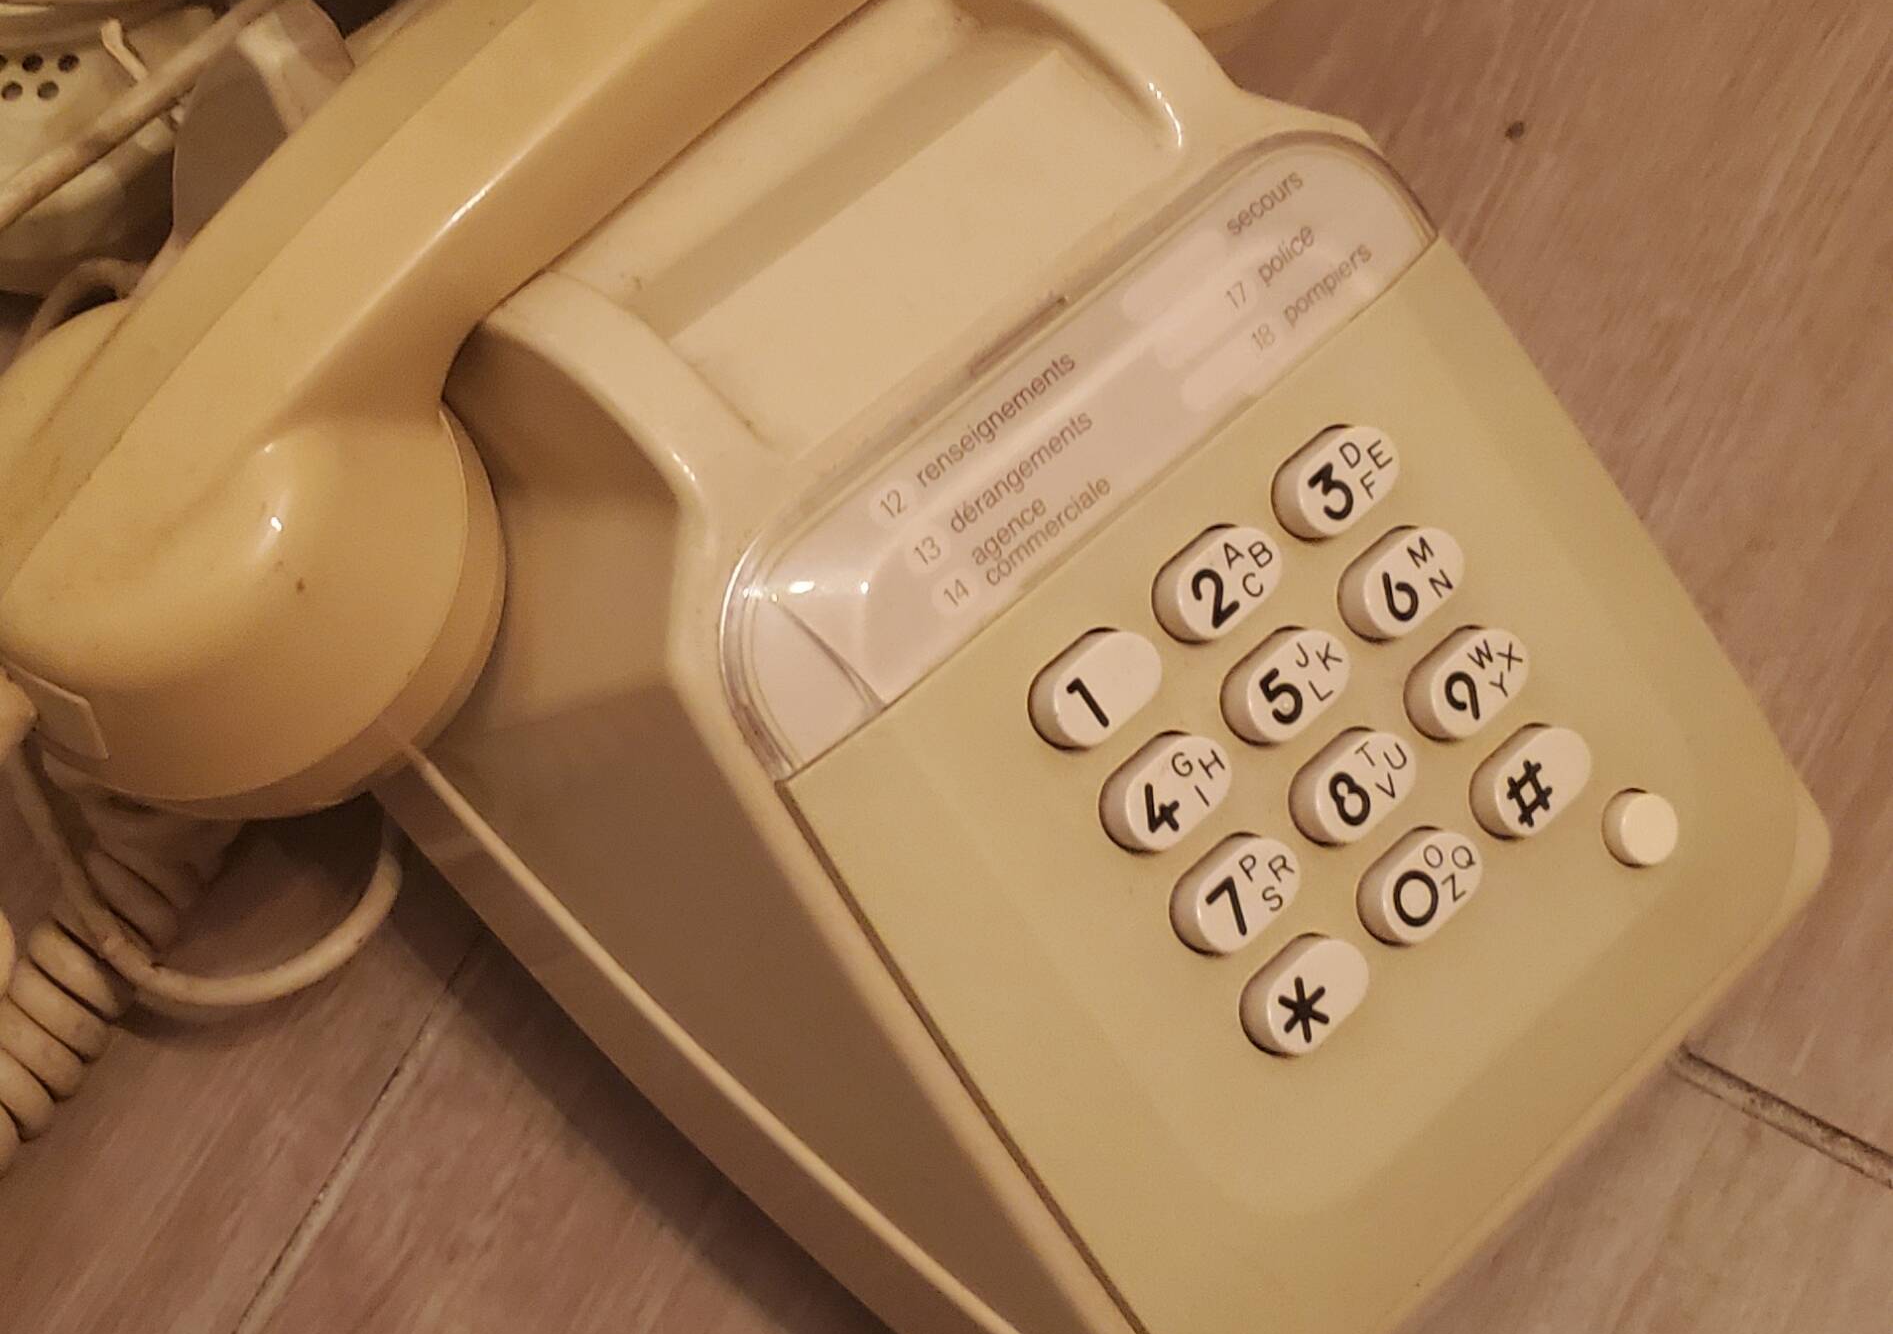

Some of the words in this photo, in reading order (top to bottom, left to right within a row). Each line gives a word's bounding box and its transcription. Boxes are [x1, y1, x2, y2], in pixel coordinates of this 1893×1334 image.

[1226, 171, 1304, 236] secours
[1226, 281, 1247, 310] 17
[1258, 224, 1315, 288] police
[1252, 323, 1276, 351] 18
[1283, 243, 1373, 329] pompiers
[879, 488, 908, 519] 12
[916, 353, 1076, 489] renseignements
[913, 535, 942, 566] 13
[950, 412, 1093, 534] dérangements
[1307, 461, 1354, 522] 3
[943, 578, 970, 608] 14
[985, 477, 1112, 587] commerciale
[971, 498, 1047, 567] agence
[1191, 567, 1240, 630] 2
[1381, 571, 1419, 623] 6
[1066, 677, 1110, 729] 1
[1258, 667, 1303, 726] 5
[1444, 670, 1481, 721] 9
[1144, 782, 1180, 834] 4
[1328, 771, 1371, 828] 8
[1205, 875, 1247, 937] 7
